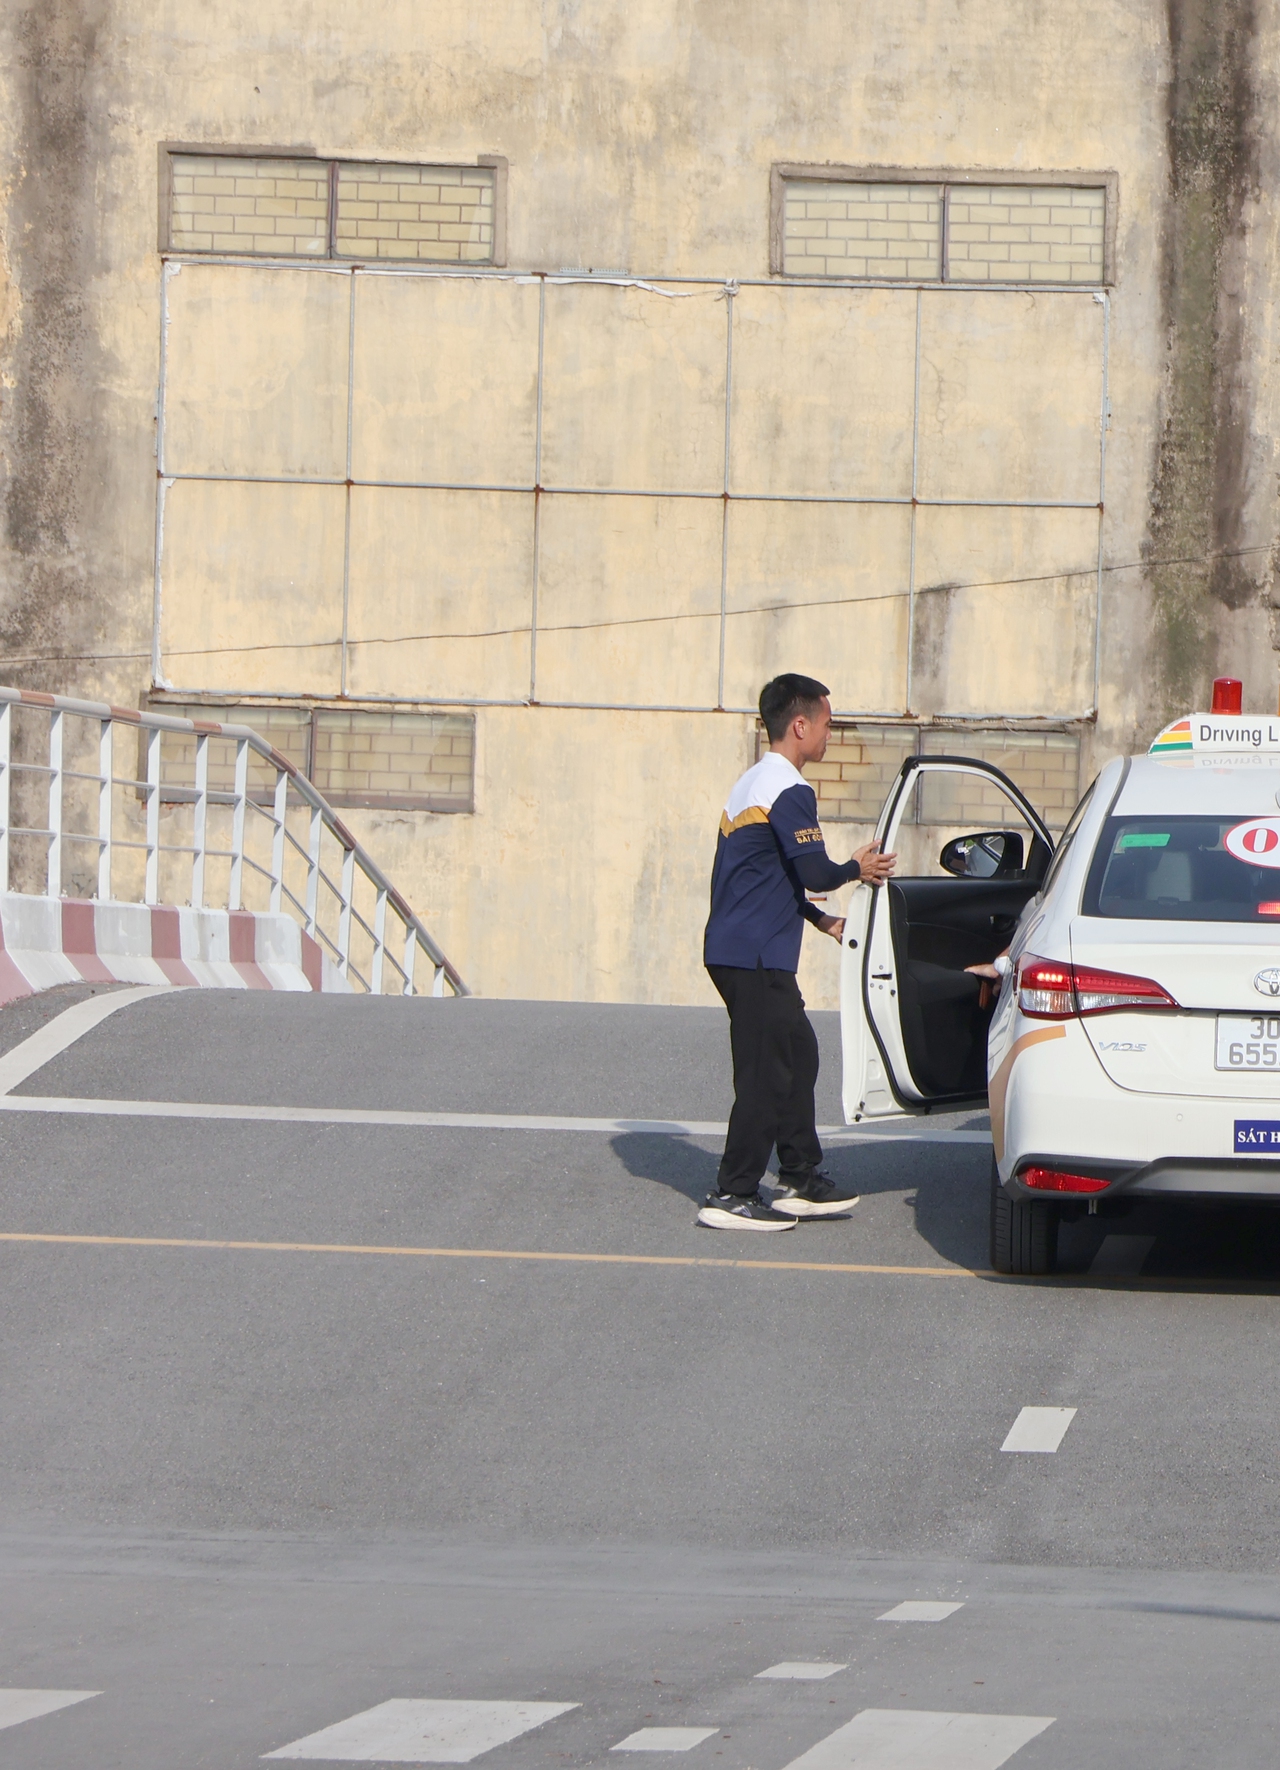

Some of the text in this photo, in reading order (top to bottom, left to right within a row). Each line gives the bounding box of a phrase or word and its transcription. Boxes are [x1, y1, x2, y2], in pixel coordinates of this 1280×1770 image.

[1199, 724, 1262, 747] Driving
[1098, 1041, 1147, 1053] VIOS
[1237, 1127, 1267, 1143] SÁT
